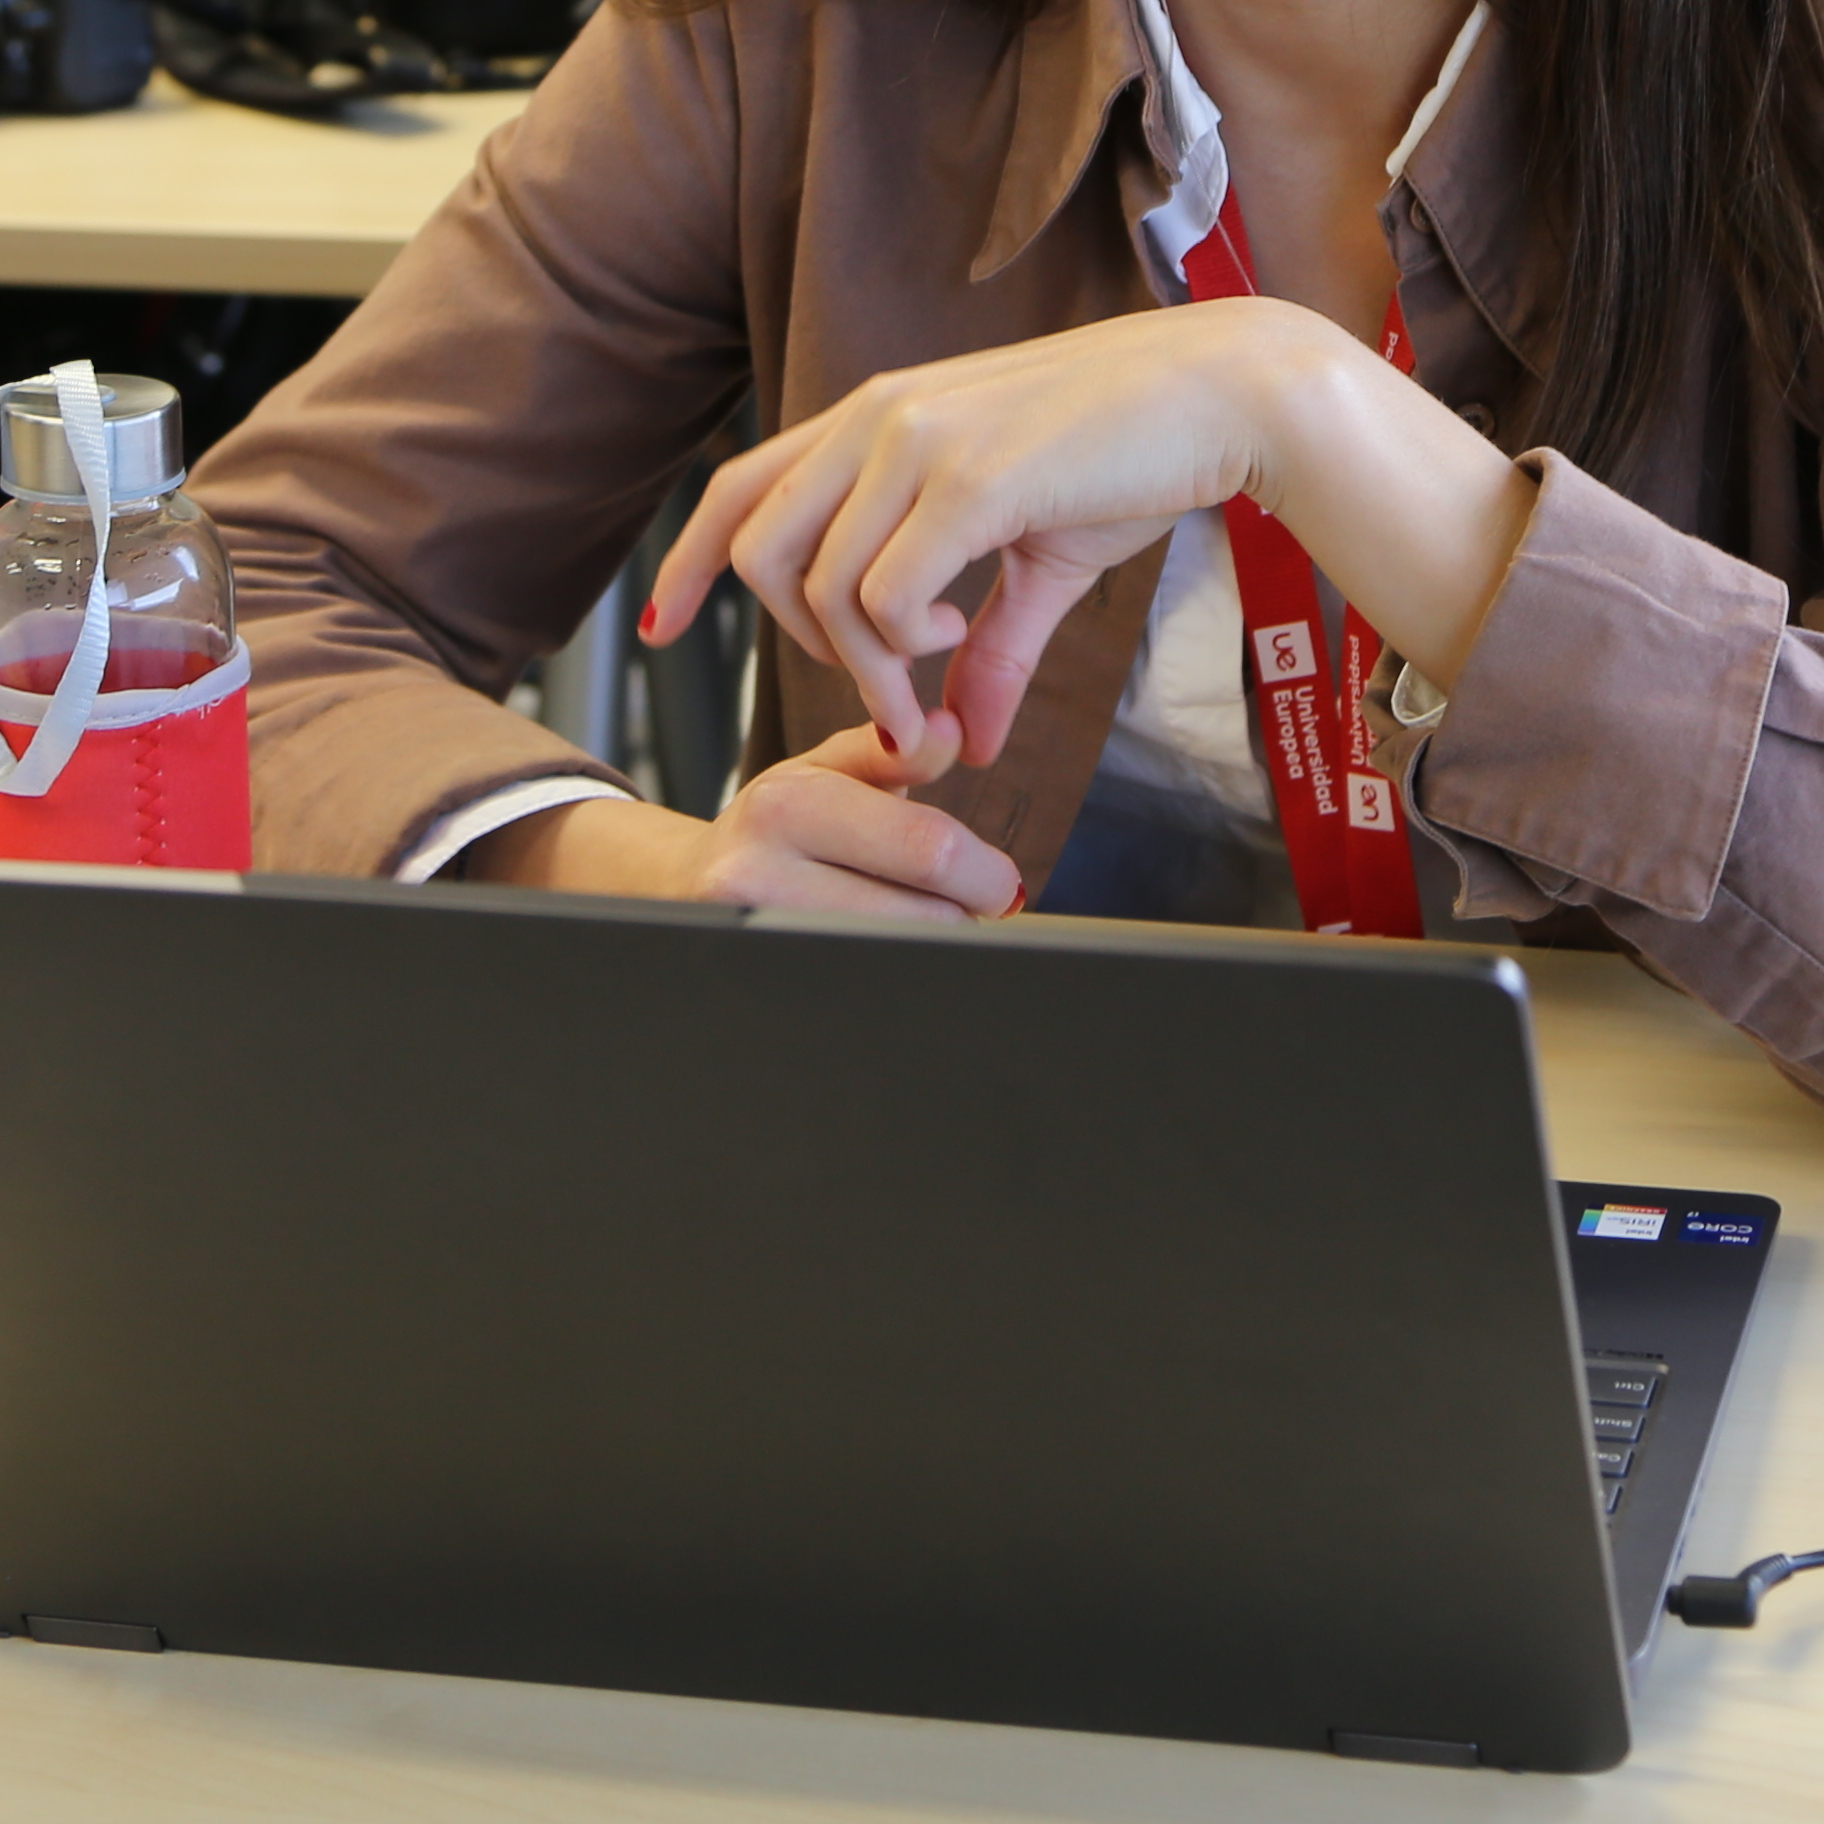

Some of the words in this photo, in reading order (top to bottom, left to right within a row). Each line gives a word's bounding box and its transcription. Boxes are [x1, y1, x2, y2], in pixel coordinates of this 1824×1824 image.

[1272, 688, 1304, 781] Europea
[1294, 685, 1339, 816] Universidad
[1347, 634, 1366, 766] Universidad
[1614, 1380, 1645, 1392] Ctrl
